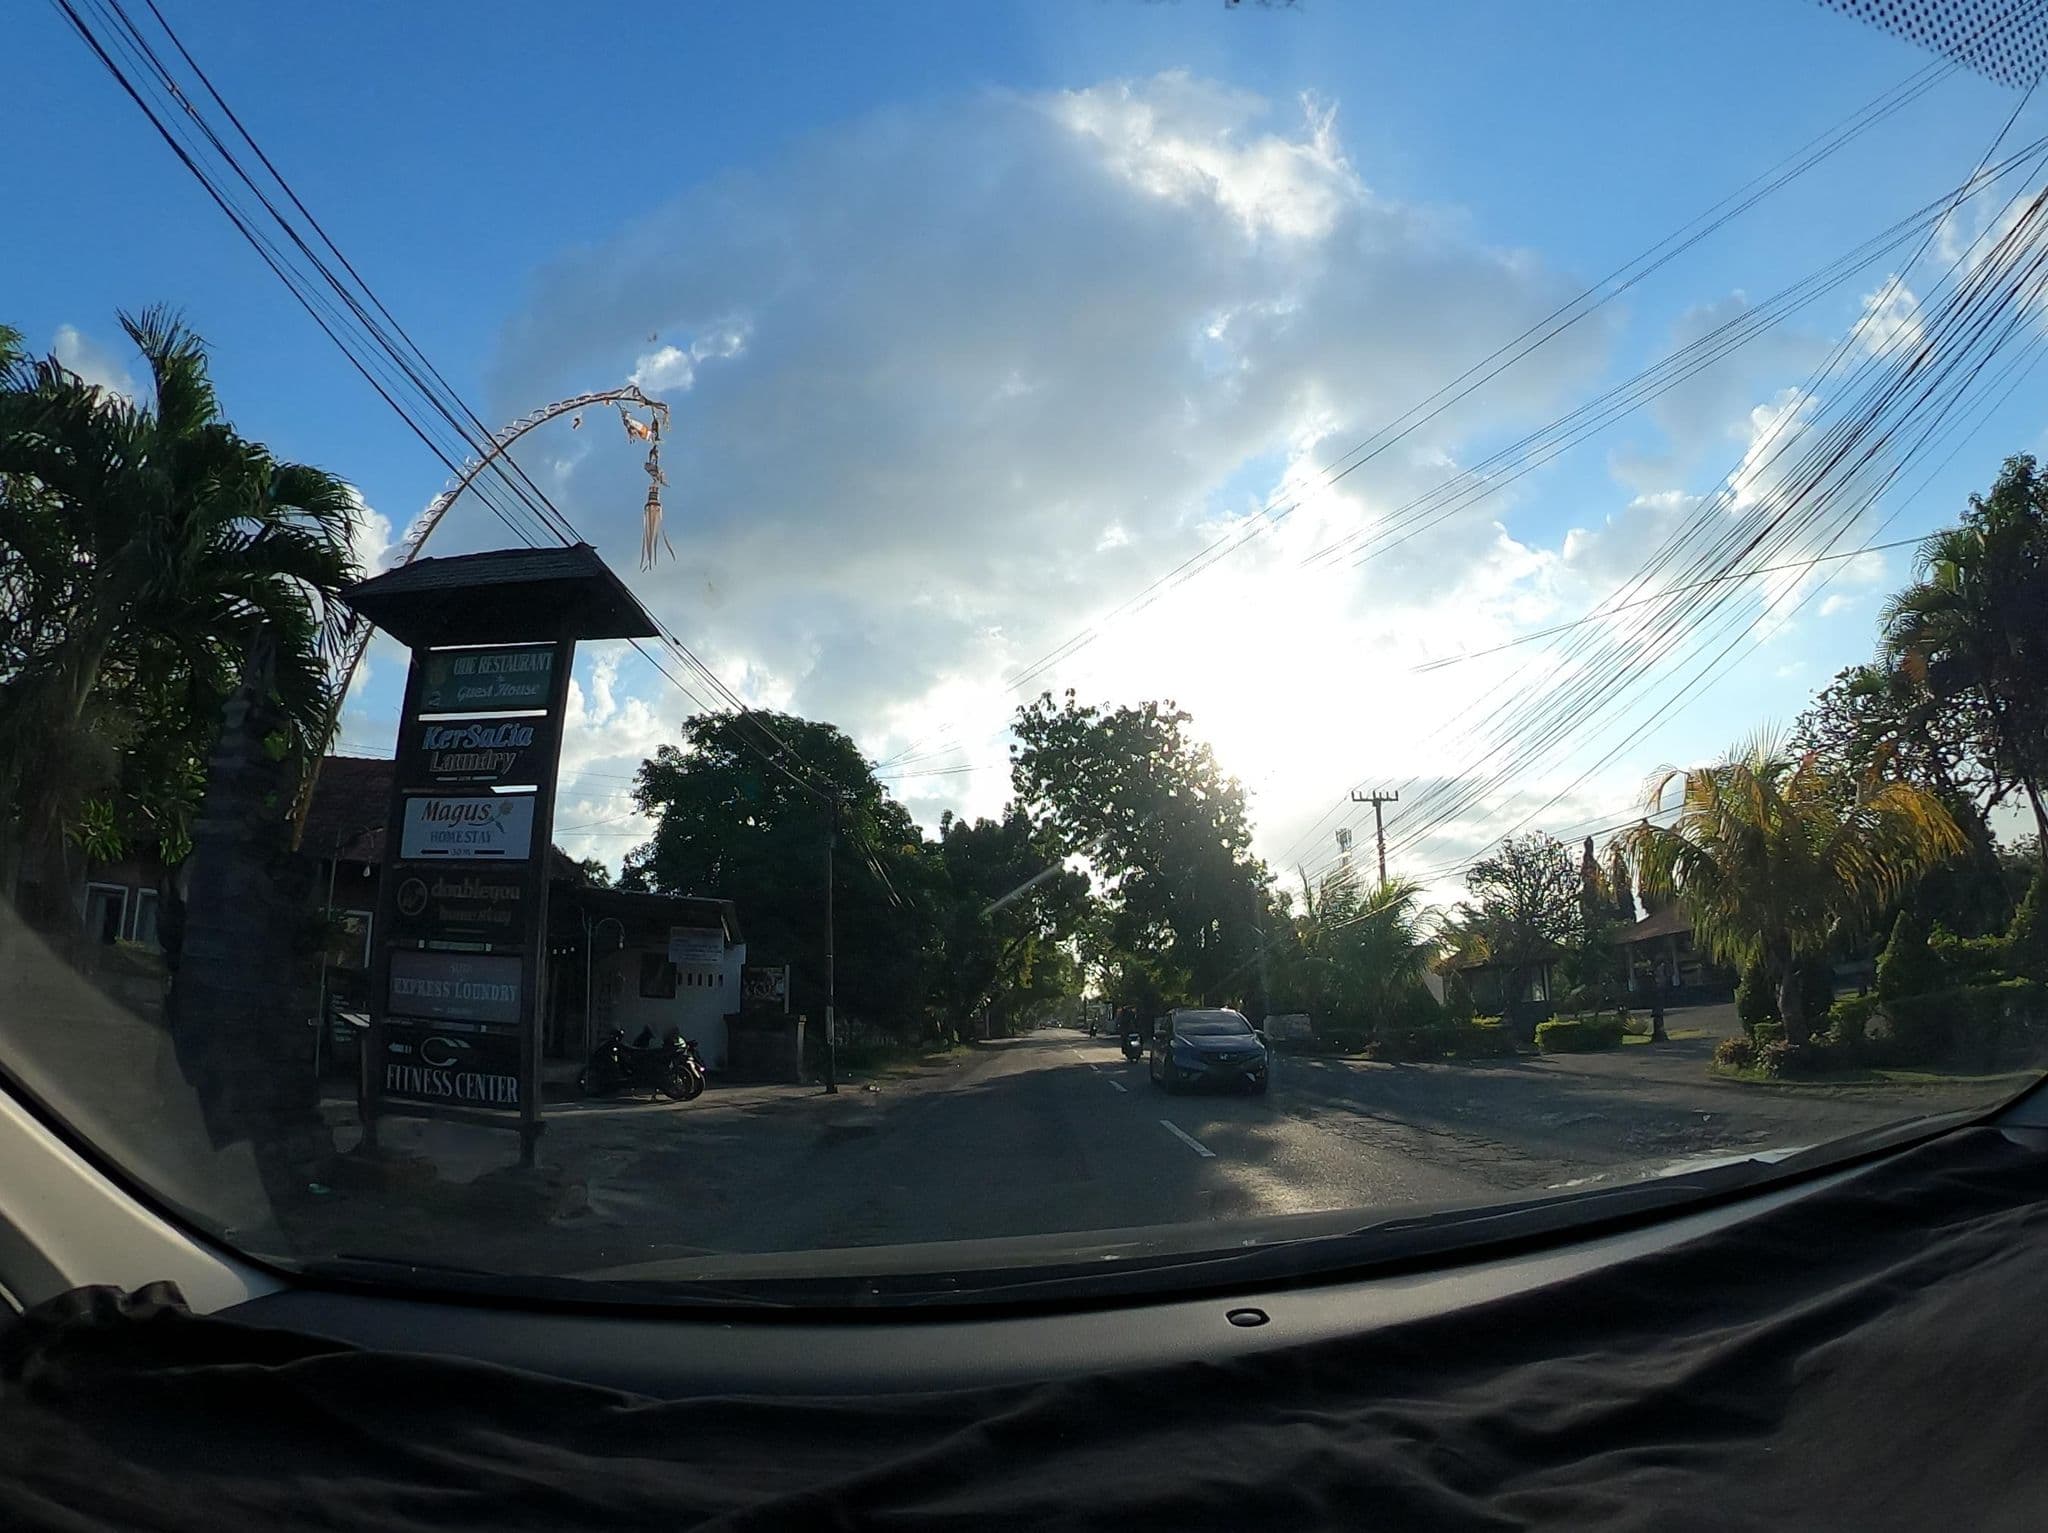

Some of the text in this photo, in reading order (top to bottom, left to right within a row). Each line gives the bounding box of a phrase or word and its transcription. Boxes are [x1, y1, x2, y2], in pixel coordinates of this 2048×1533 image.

[478, 653, 554, 674] RESTAURANT
[457, 682, 538, 703] Guest House
[430, 749, 517, 775] Laundry
[421, 799, 492, 828] Magus
[430, 830, 492, 844] HOMESTAY
[392, 976, 450, 998] EXPRESS
[385, 1063, 520, 1103] FITNESS CENTER
